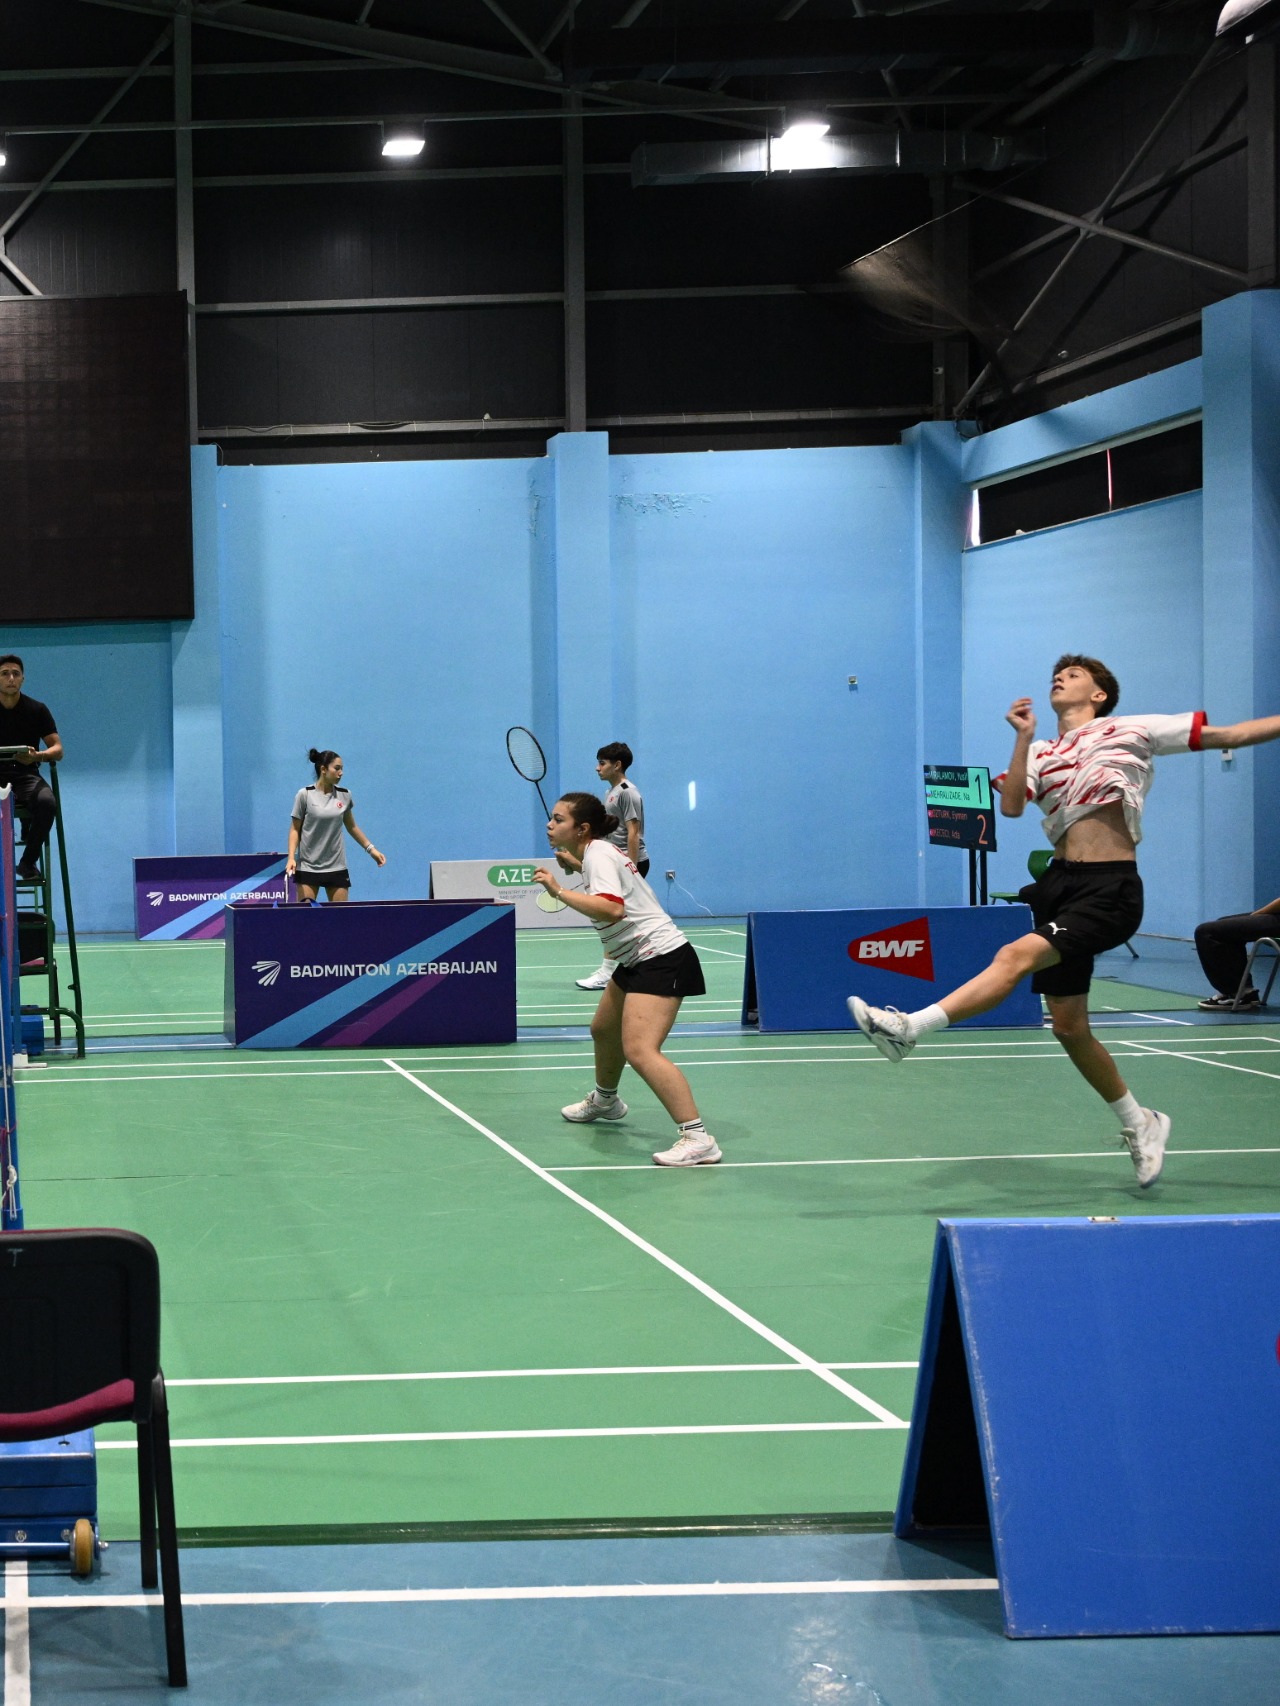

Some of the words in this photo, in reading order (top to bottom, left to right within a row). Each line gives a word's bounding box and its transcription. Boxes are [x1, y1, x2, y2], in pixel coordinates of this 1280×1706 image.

[974, 774, 982, 804] 1
[976, 814, 988, 845] 2
[497, 868, 531, 883] AZE
[168, 892, 227, 902] BADMINTON
[858, 940, 925, 958] BWF
[290, 963, 390, 978] BADMINTON
[396, 961, 497, 976] AZERBAIJAN
